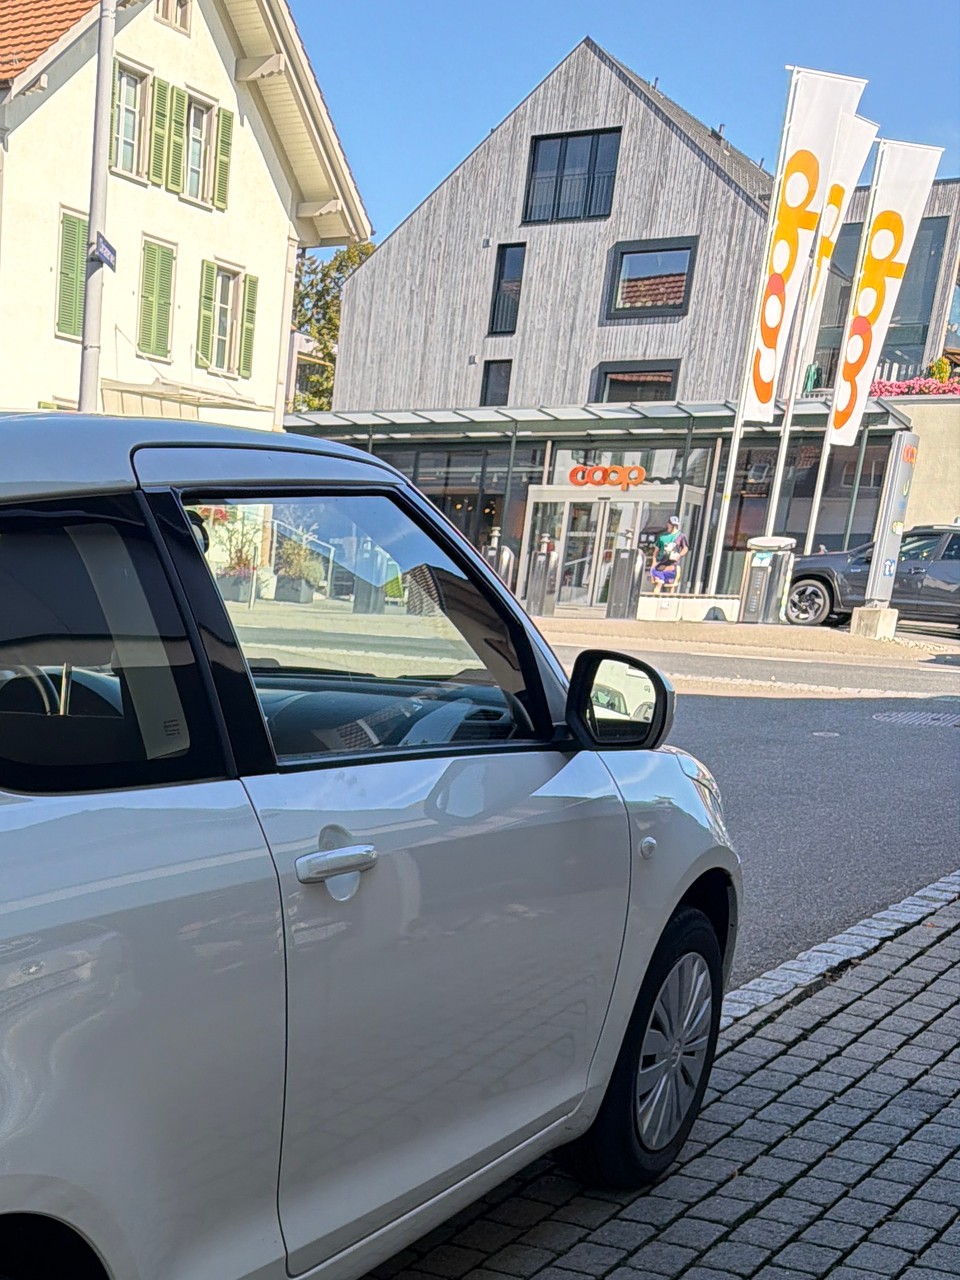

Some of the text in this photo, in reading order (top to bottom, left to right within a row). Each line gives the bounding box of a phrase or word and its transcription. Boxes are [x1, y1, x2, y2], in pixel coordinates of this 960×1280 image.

[753, 149, 820, 404] coop
[833, 210, 907, 430] coop
[569, 465, 646, 491] coop
